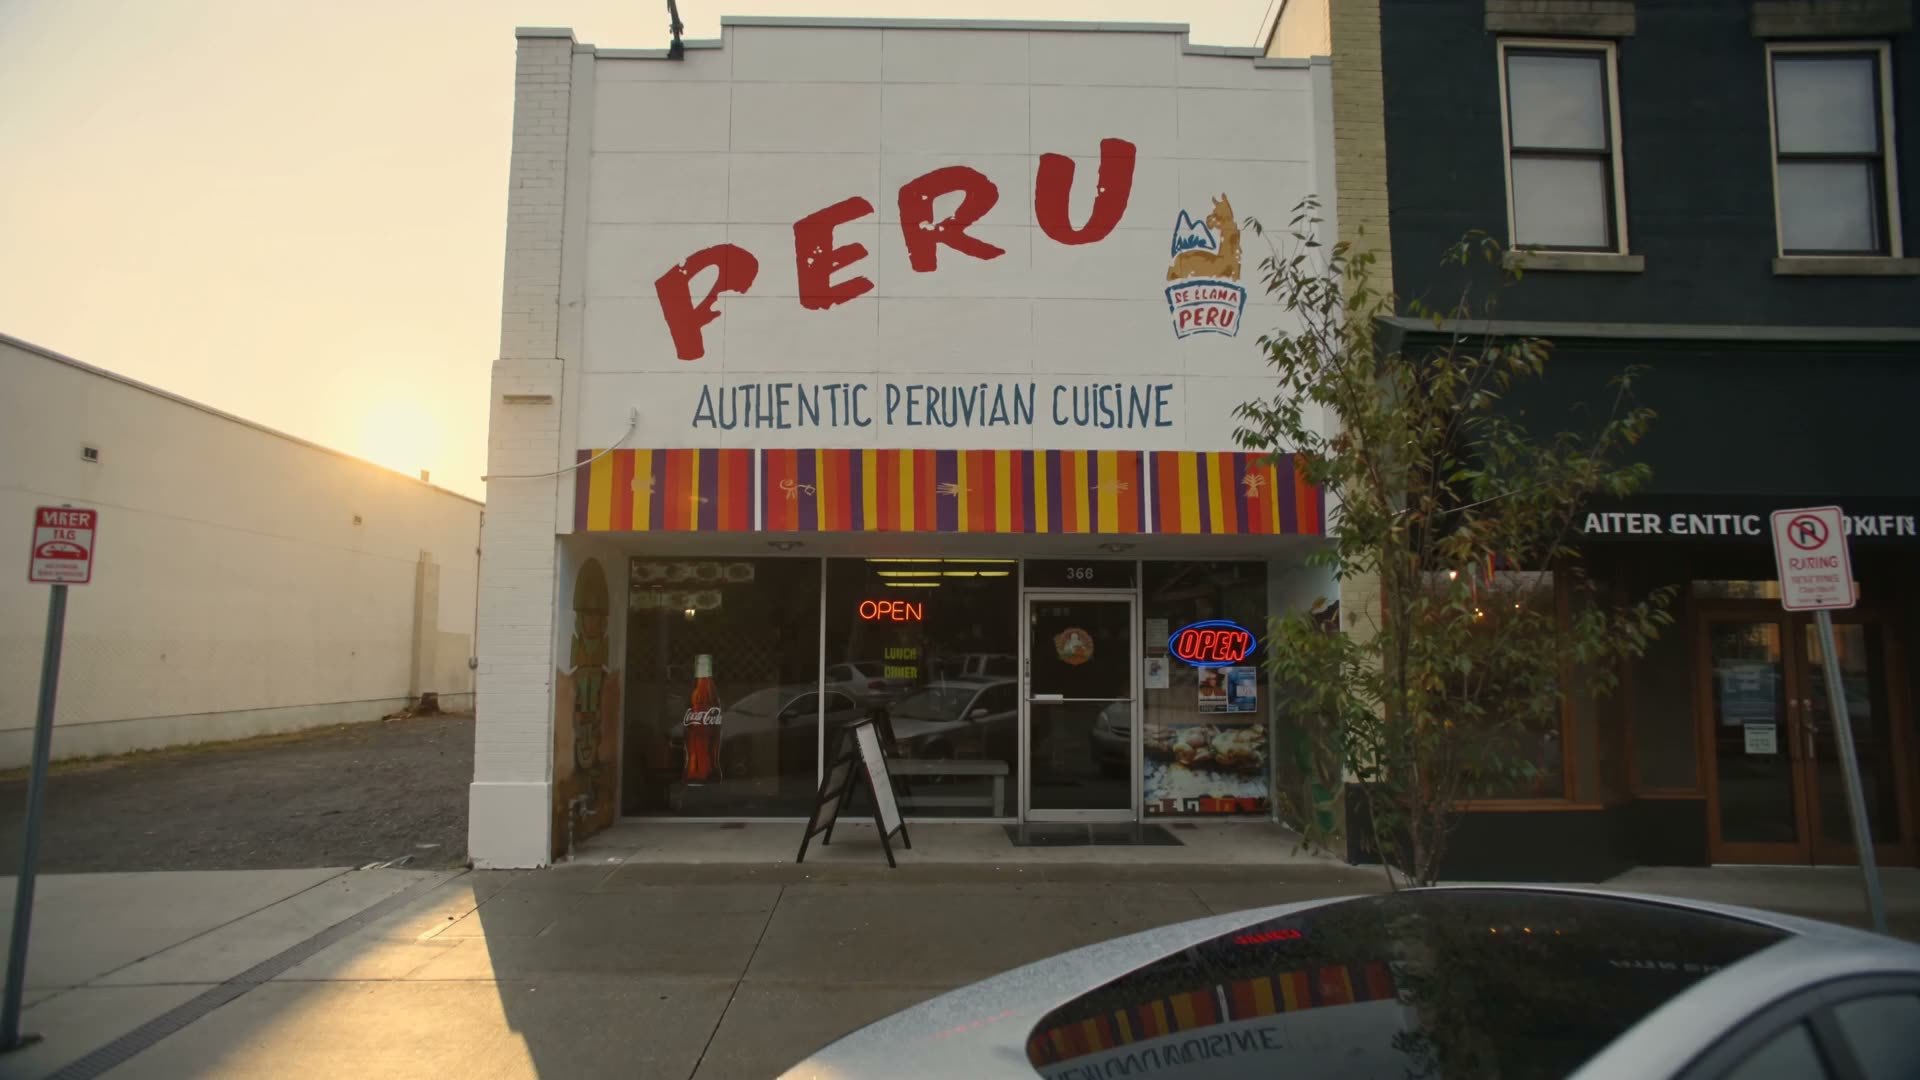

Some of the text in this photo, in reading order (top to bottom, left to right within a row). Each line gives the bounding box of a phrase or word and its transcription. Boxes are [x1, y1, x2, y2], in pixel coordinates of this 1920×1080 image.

[654, 137, 1137, 361] PERU
[1174, 288, 1239, 304] SE LLAMA
[1178, 306, 1235, 329] PERU
[886, 383, 1036, 428] PERUVIAN
[1053, 383, 1173, 429] CUISINE
[859, 600, 923, 621] OPEN
[1178, 629, 1250, 662] OPEN
